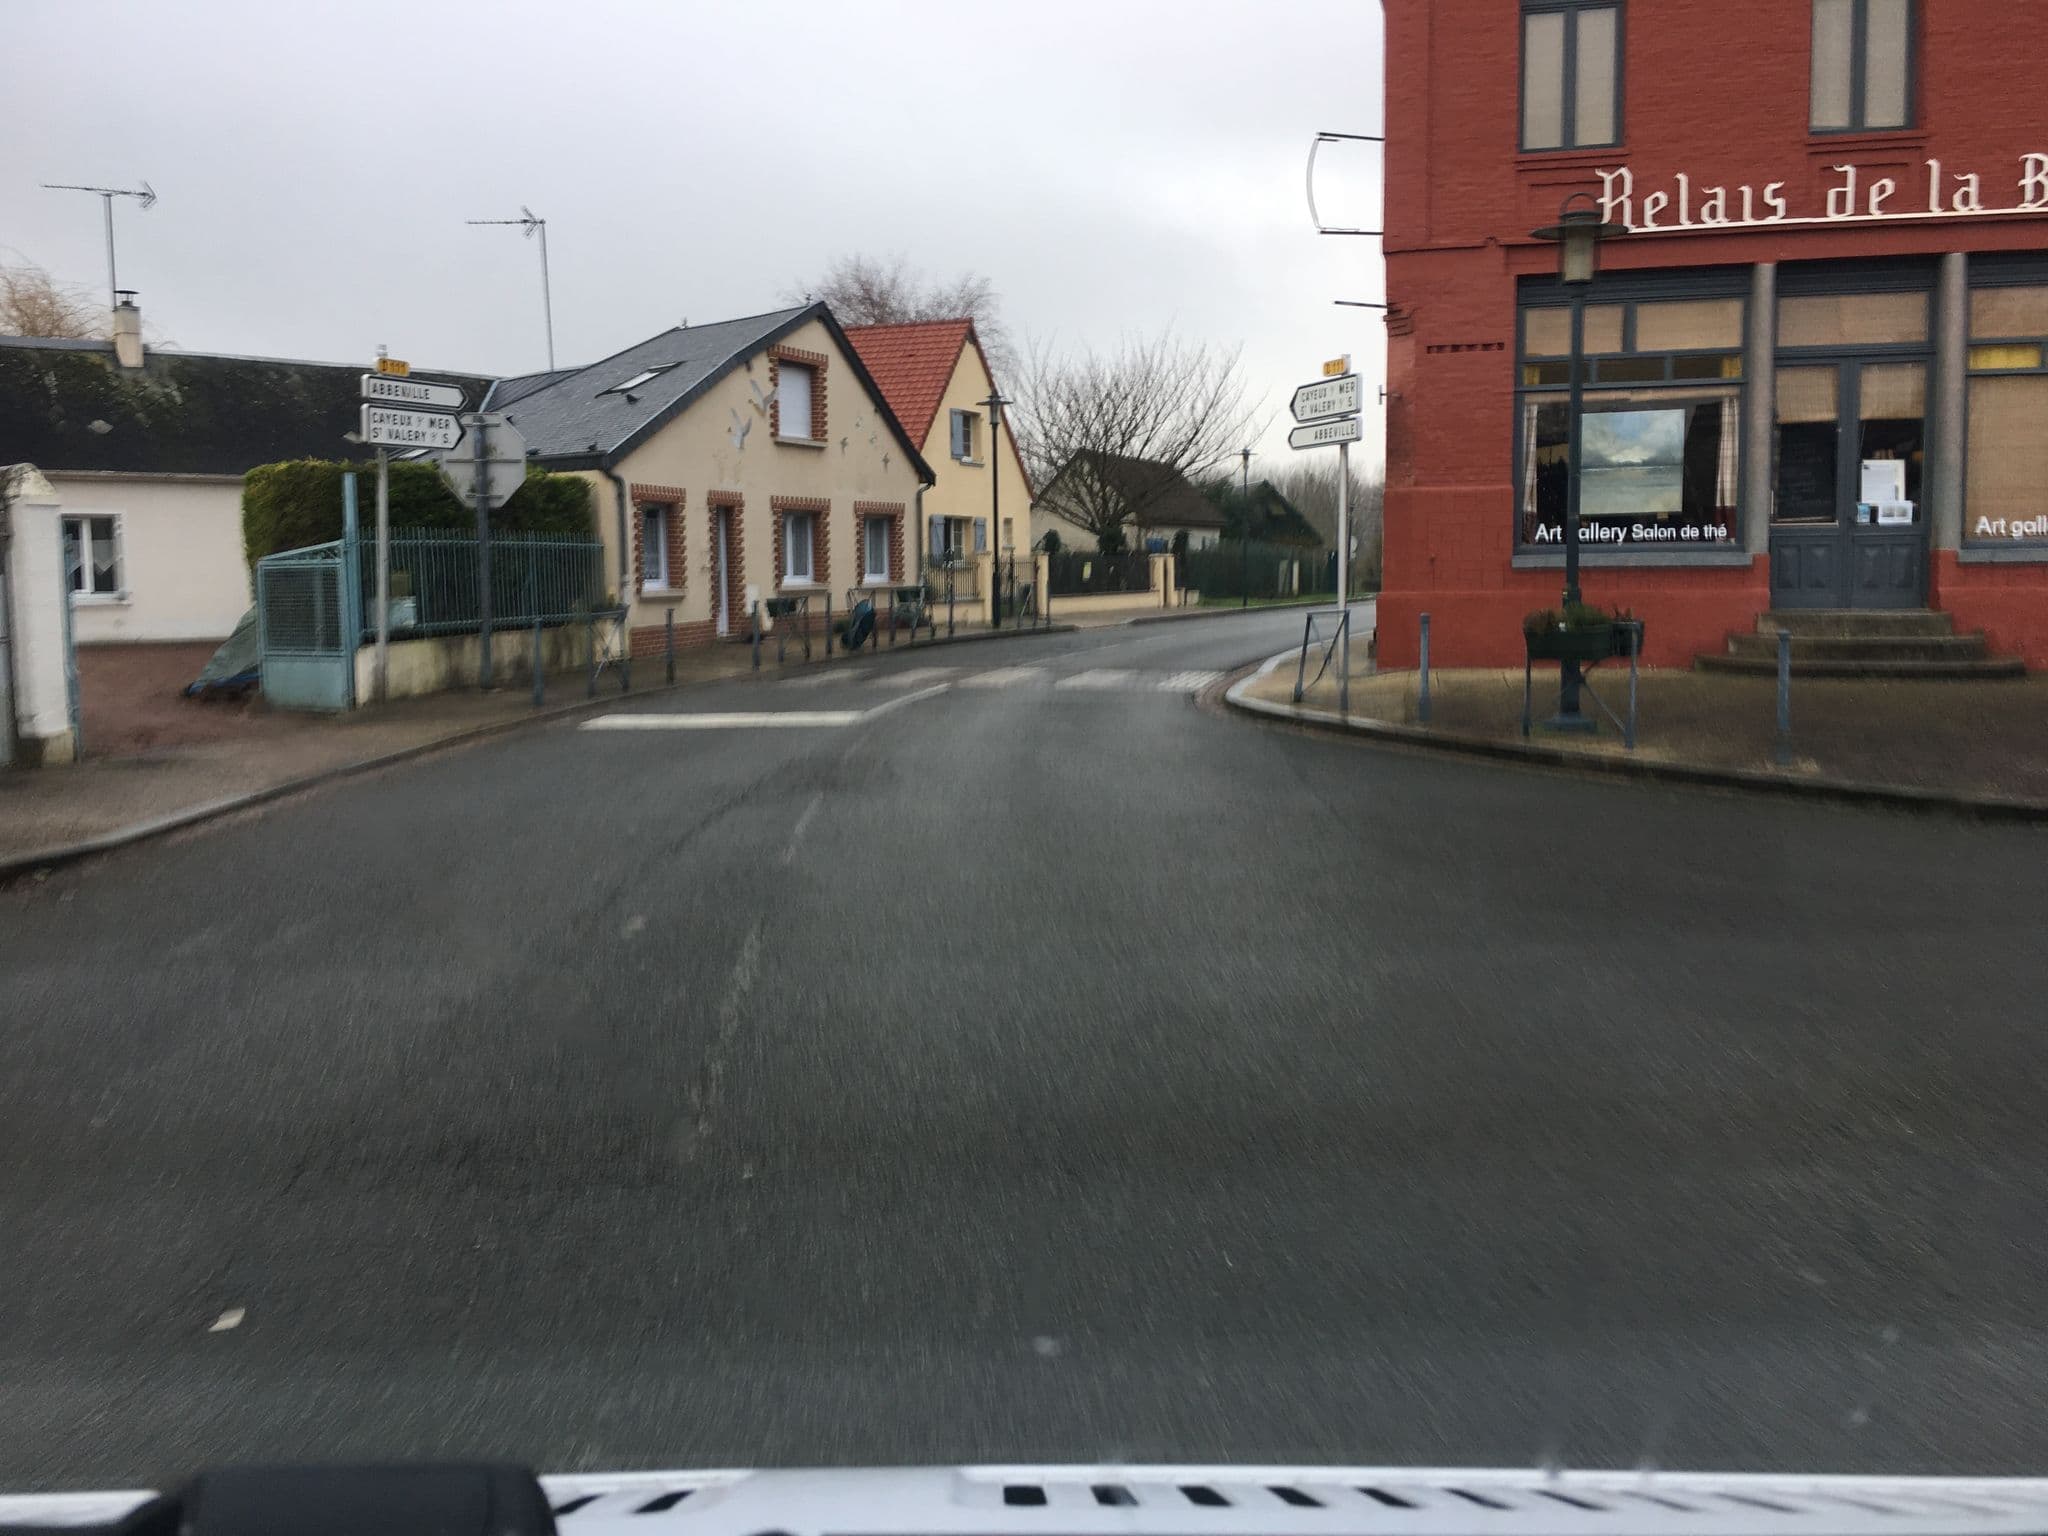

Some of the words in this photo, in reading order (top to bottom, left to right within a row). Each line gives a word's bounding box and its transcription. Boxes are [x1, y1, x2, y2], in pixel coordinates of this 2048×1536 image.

[1595, 164, 1787, 231] Relais
[1825, 164, 1896, 218] de
[1925, 158, 1985, 214] la
[372, 382, 431, 400] ABBEVILLE
[1338, 381, 1356, 395] MER
[1310, 399, 1336, 415] VALERY
[372, 412, 413, 427] CAYEUX
[429, 417, 451, 430] MER
[388, 428, 427, 441] VALERY
[1313, 423, 1355, 440] ABBEVILLE
[1535, 523, 1563, 542] Art
[1577, 522, 1628, 546] allery
[1631, 523, 1677, 542] Salon
[1680, 524, 1700, 541] de
[1703, 523, 1728, 541] thé
[1974, 515, 2007, 537] Art
